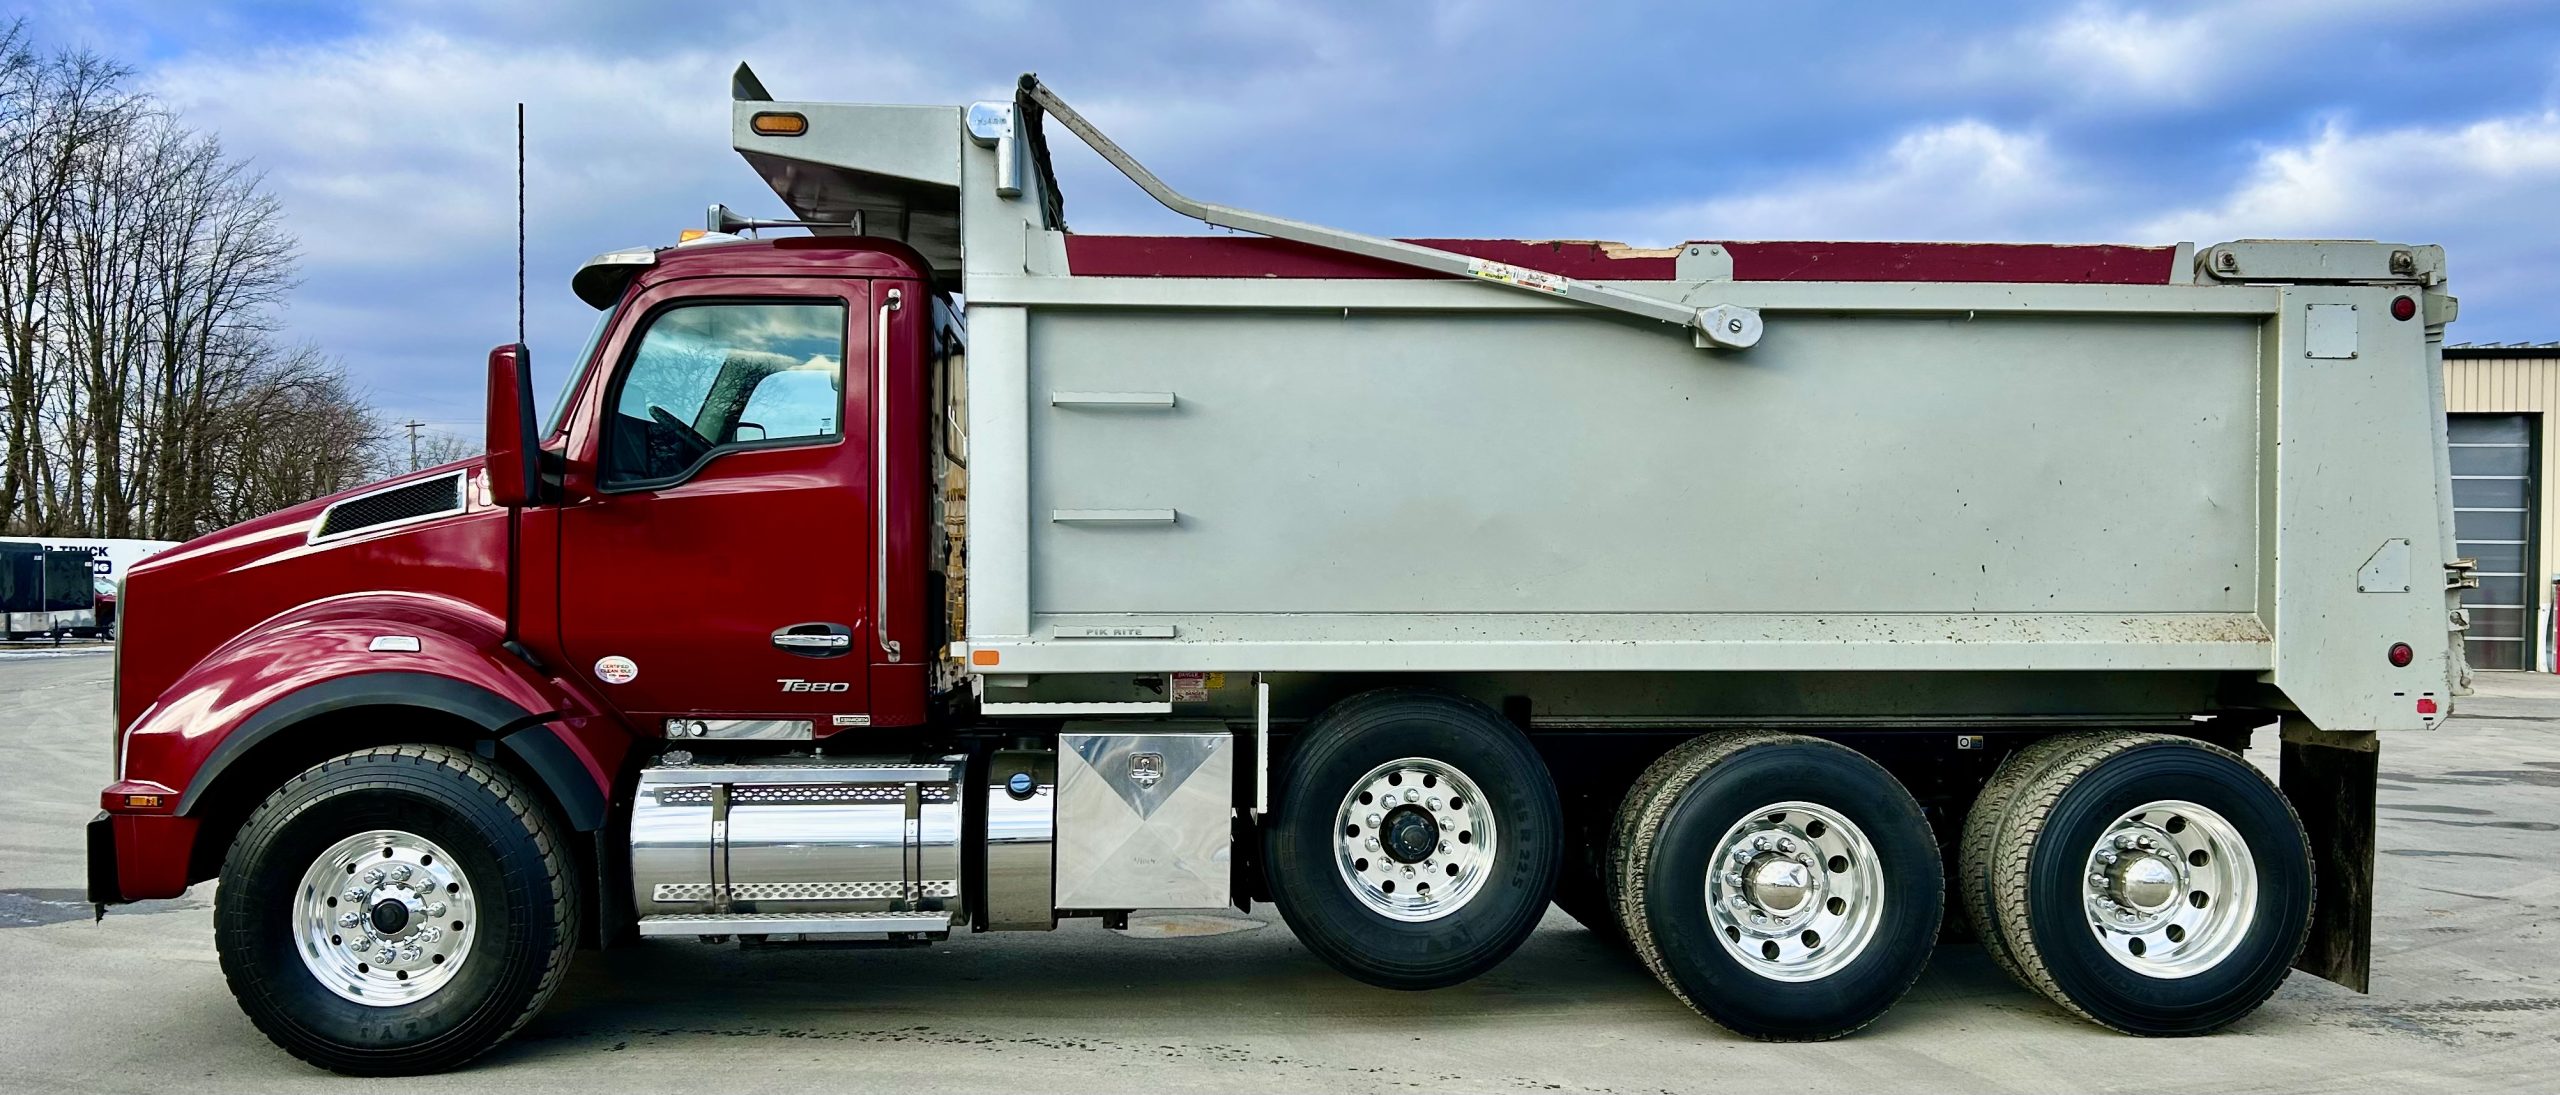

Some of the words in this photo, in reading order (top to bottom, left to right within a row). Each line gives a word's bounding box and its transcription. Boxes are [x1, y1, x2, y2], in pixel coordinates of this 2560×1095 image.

[1086, 628, 1108, 636] PIK
[1113, 628, 1143, 636] RITE
[776, 678, 850, 692] T880
